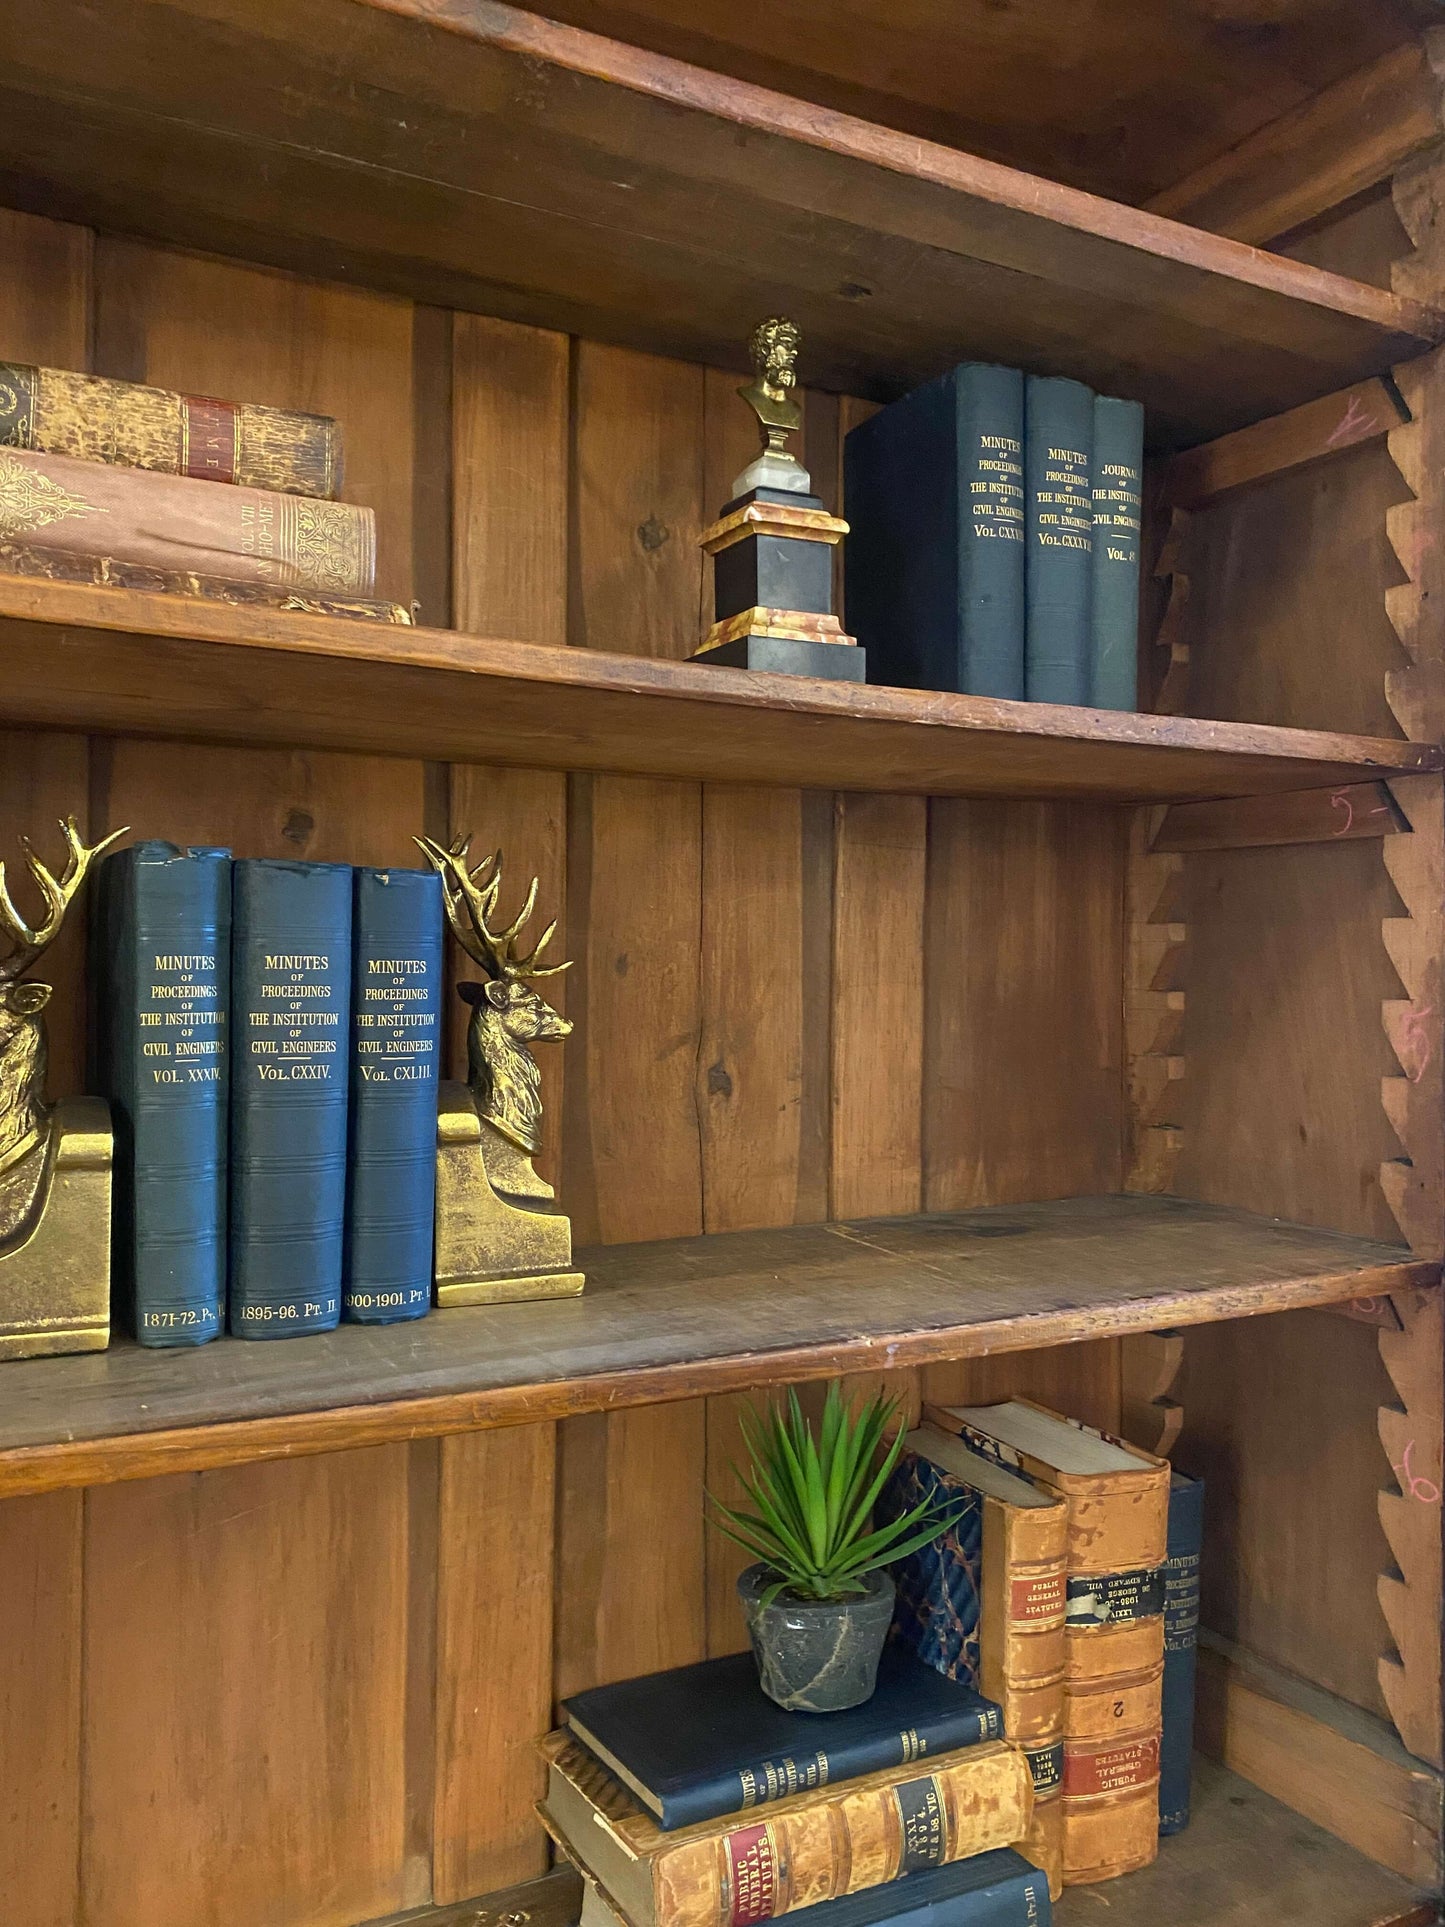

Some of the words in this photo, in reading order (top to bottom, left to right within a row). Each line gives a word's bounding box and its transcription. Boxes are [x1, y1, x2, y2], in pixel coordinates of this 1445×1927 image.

[981, 435, 1021, 453] MINUTES
[1048, 448, 1087, 466] MINUTES
[999, 474, 1008, 482] OF
[970, 482, 987, 493] THE
[1064, 485, 1074, 493] OF
[1037, 492, 1053, 503] THE
[973, 504, 994, 515] CIVIL
[1118, 504, 1128, 512] OF
[241, 505, 255, 527] VIII
[1039, 513, 1059, 524] CIVIL
[155, 955, 215, 970] MINUTES
[264, 955, 329, 970] MINUTES
[368, 960, 427, 974] MINUTES
[181, 974, 193, 982] OF
[290, 973, 304, 981] OF
[392, 977, 405, 985] OF
[151, 985, 217, 999] PROCEEDINGS
[261, 985, 332, 998] PROCEEDINGS
[365, 988, 428, 1000] PROCEEDINGS
[181, 1002, 193, 1010] OF
[289, 1001, 302, 1010] OF
[393, 1003, 405, 1011] OF
[140, 1013, 161, 1026] THE
[249, 1012, 270, 1025] THE
[272, 1012, 340, 1025] INSTITUTION
[356, 1014, 374, 1026] THE
[377, 1013, 435, 1026] INSTITUTION
[181, 1028, 193, 1037] OF
[289, 1029, 302, 1037] OF
[393, 1029, 404, 1038] OF
[143, 1042, 171, 1056] CIVIL
[175, 1041, 225, 1055] ENGINEERS
[251, 1041, 279, 1053] CIVIL
[281, 1040, 337, 1053] ENGINEERS
[358, 1041, 383, 1053] CIVIL
[386, 1040, 433, 1053] ENGINEERS
[153, 1070, 184, 1083] VOL.
[188, 1067, 221, 1082] XXXIV.
[291, 1064, 332, 1080] CXXIV.
[393, 1065, 432, 1080] CXLIII.
[240, 1304, 299, 1320] 1895-96.
[1402, 1439, 1440, 1503] 6
[1032, 1580, 1059, 1591] PUBLIC
[1108, 1577, 1142, 1588] EDWARD
[1027, 1590, 1061, 1602] GENERAL
[1107, 1587, 1138, 1598] GEORGE
[1025, 1601, 1062, 1614] STATUTES
[1113, 1700, 1124, 1719] 2
[1095, 1749, 1142, 1766] STATUTES
[806, 1764, 817, 1786] CIVIL
[1101, 1774, 1136, 1789] PUBLIC
[929, 1835, 939, 1844] &
[737, 1860, 750, 1913] PUBLIC
[746, 1845, 760, 1917] GENERAL
